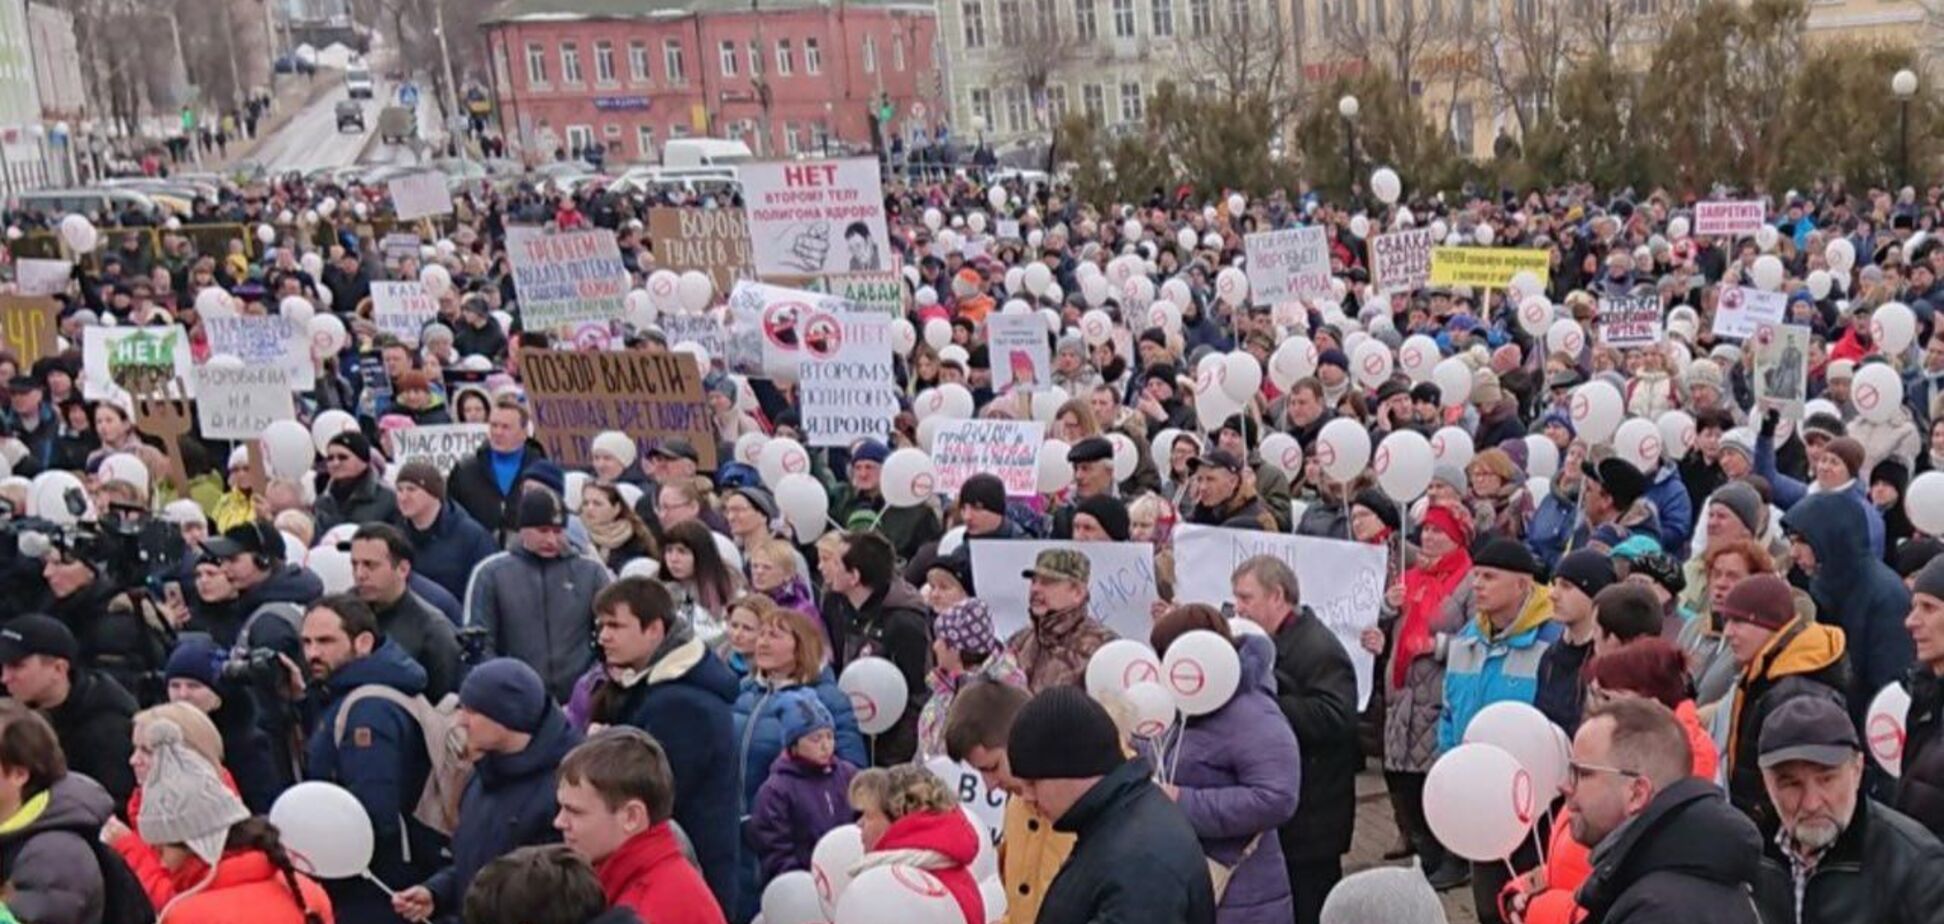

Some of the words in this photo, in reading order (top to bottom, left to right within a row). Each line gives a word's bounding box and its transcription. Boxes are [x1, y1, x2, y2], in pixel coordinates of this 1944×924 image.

[784, 164, 837, 187] НЕТ
[764, 190, 824, 203] ВТОРОМУ
[828, 188, 858, 201] ТЕЛУ
[752, 207, 822, 221] ПОЛИГОНА
[825, 204, 879, 219] ЯДРОВО!
[1699, 205, 1762, 218] ЗАПРЕТИТЬ
[844, 323, 888, 343] НЕТ
[118, 341, 163, 361] НЕТ
[525, 354, 597, 393] ПОЗОР
[800, 361, 891, 381] ВТОРОМУ
[801, 387, 893, 407] ПОЛИГОНУ
[535, 399, 608, 428] КОТОРАЯ
[806, 416, 891, 435] ЯДРОВО
[1090, 556, 1153, 626] ЕМСЯ
